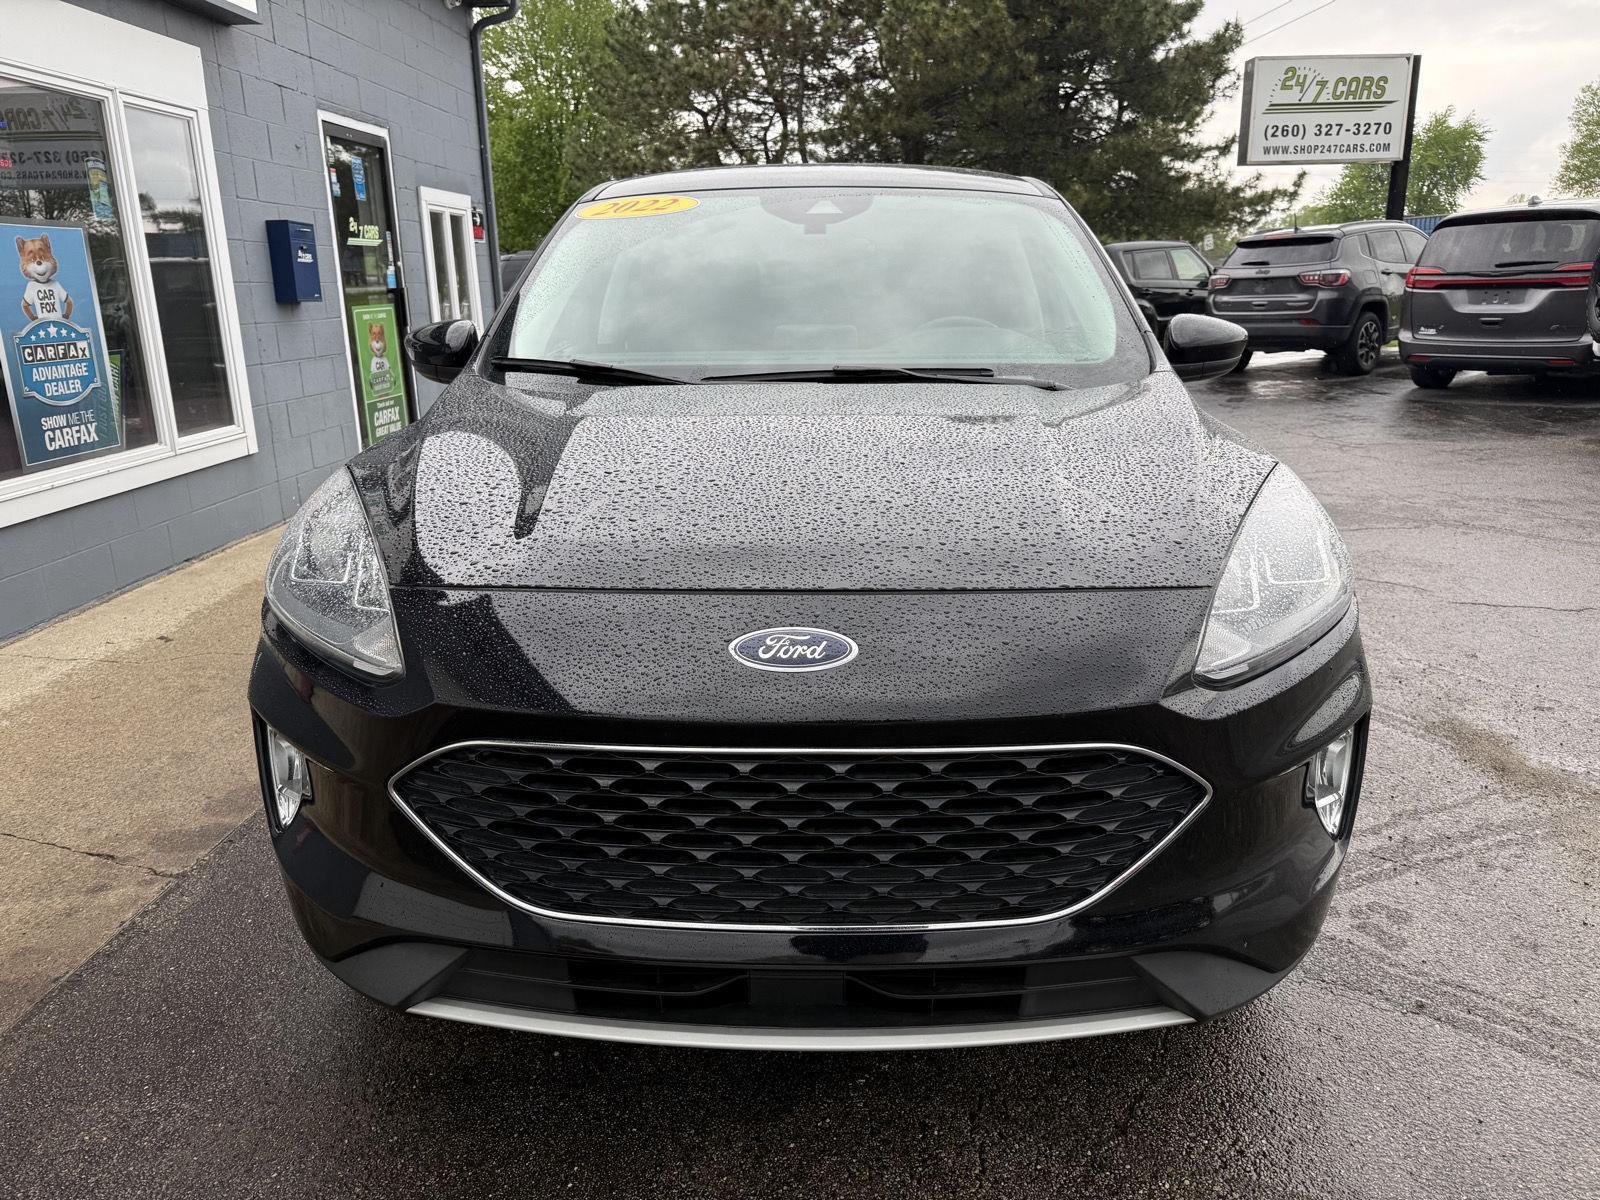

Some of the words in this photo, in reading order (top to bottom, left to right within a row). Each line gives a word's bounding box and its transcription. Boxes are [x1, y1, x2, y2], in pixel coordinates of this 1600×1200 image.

[1280, 66, 1329, 104] 24/7
[1331, 75, 1389, 101] CARS
[1264, 123, 1307, 140] (260)
[1314, 121, 1393, 138] 327-3270
[1262, 142, 1391, 156] WWW.SHOP247CARS.COM
[589, 198, 680, 217] 2022
[36, 289, 56, 302] CAR
[40, 301, 58, 314] FOX
[24, 344, 88, 362] CARFAX
[32, 363, 89, 382] ADVANTAGE
[44, 379, 83, 397] DEALER
[41, 414, 67, 430] SHOW
[68, 411, 80, 425] ME
[80, 409, 96, 423] THE
[374, 406, 400, 427] CARFAX
[44, 422, 99, 451] CARFAX
[758, 634, 828, 659] Ford
